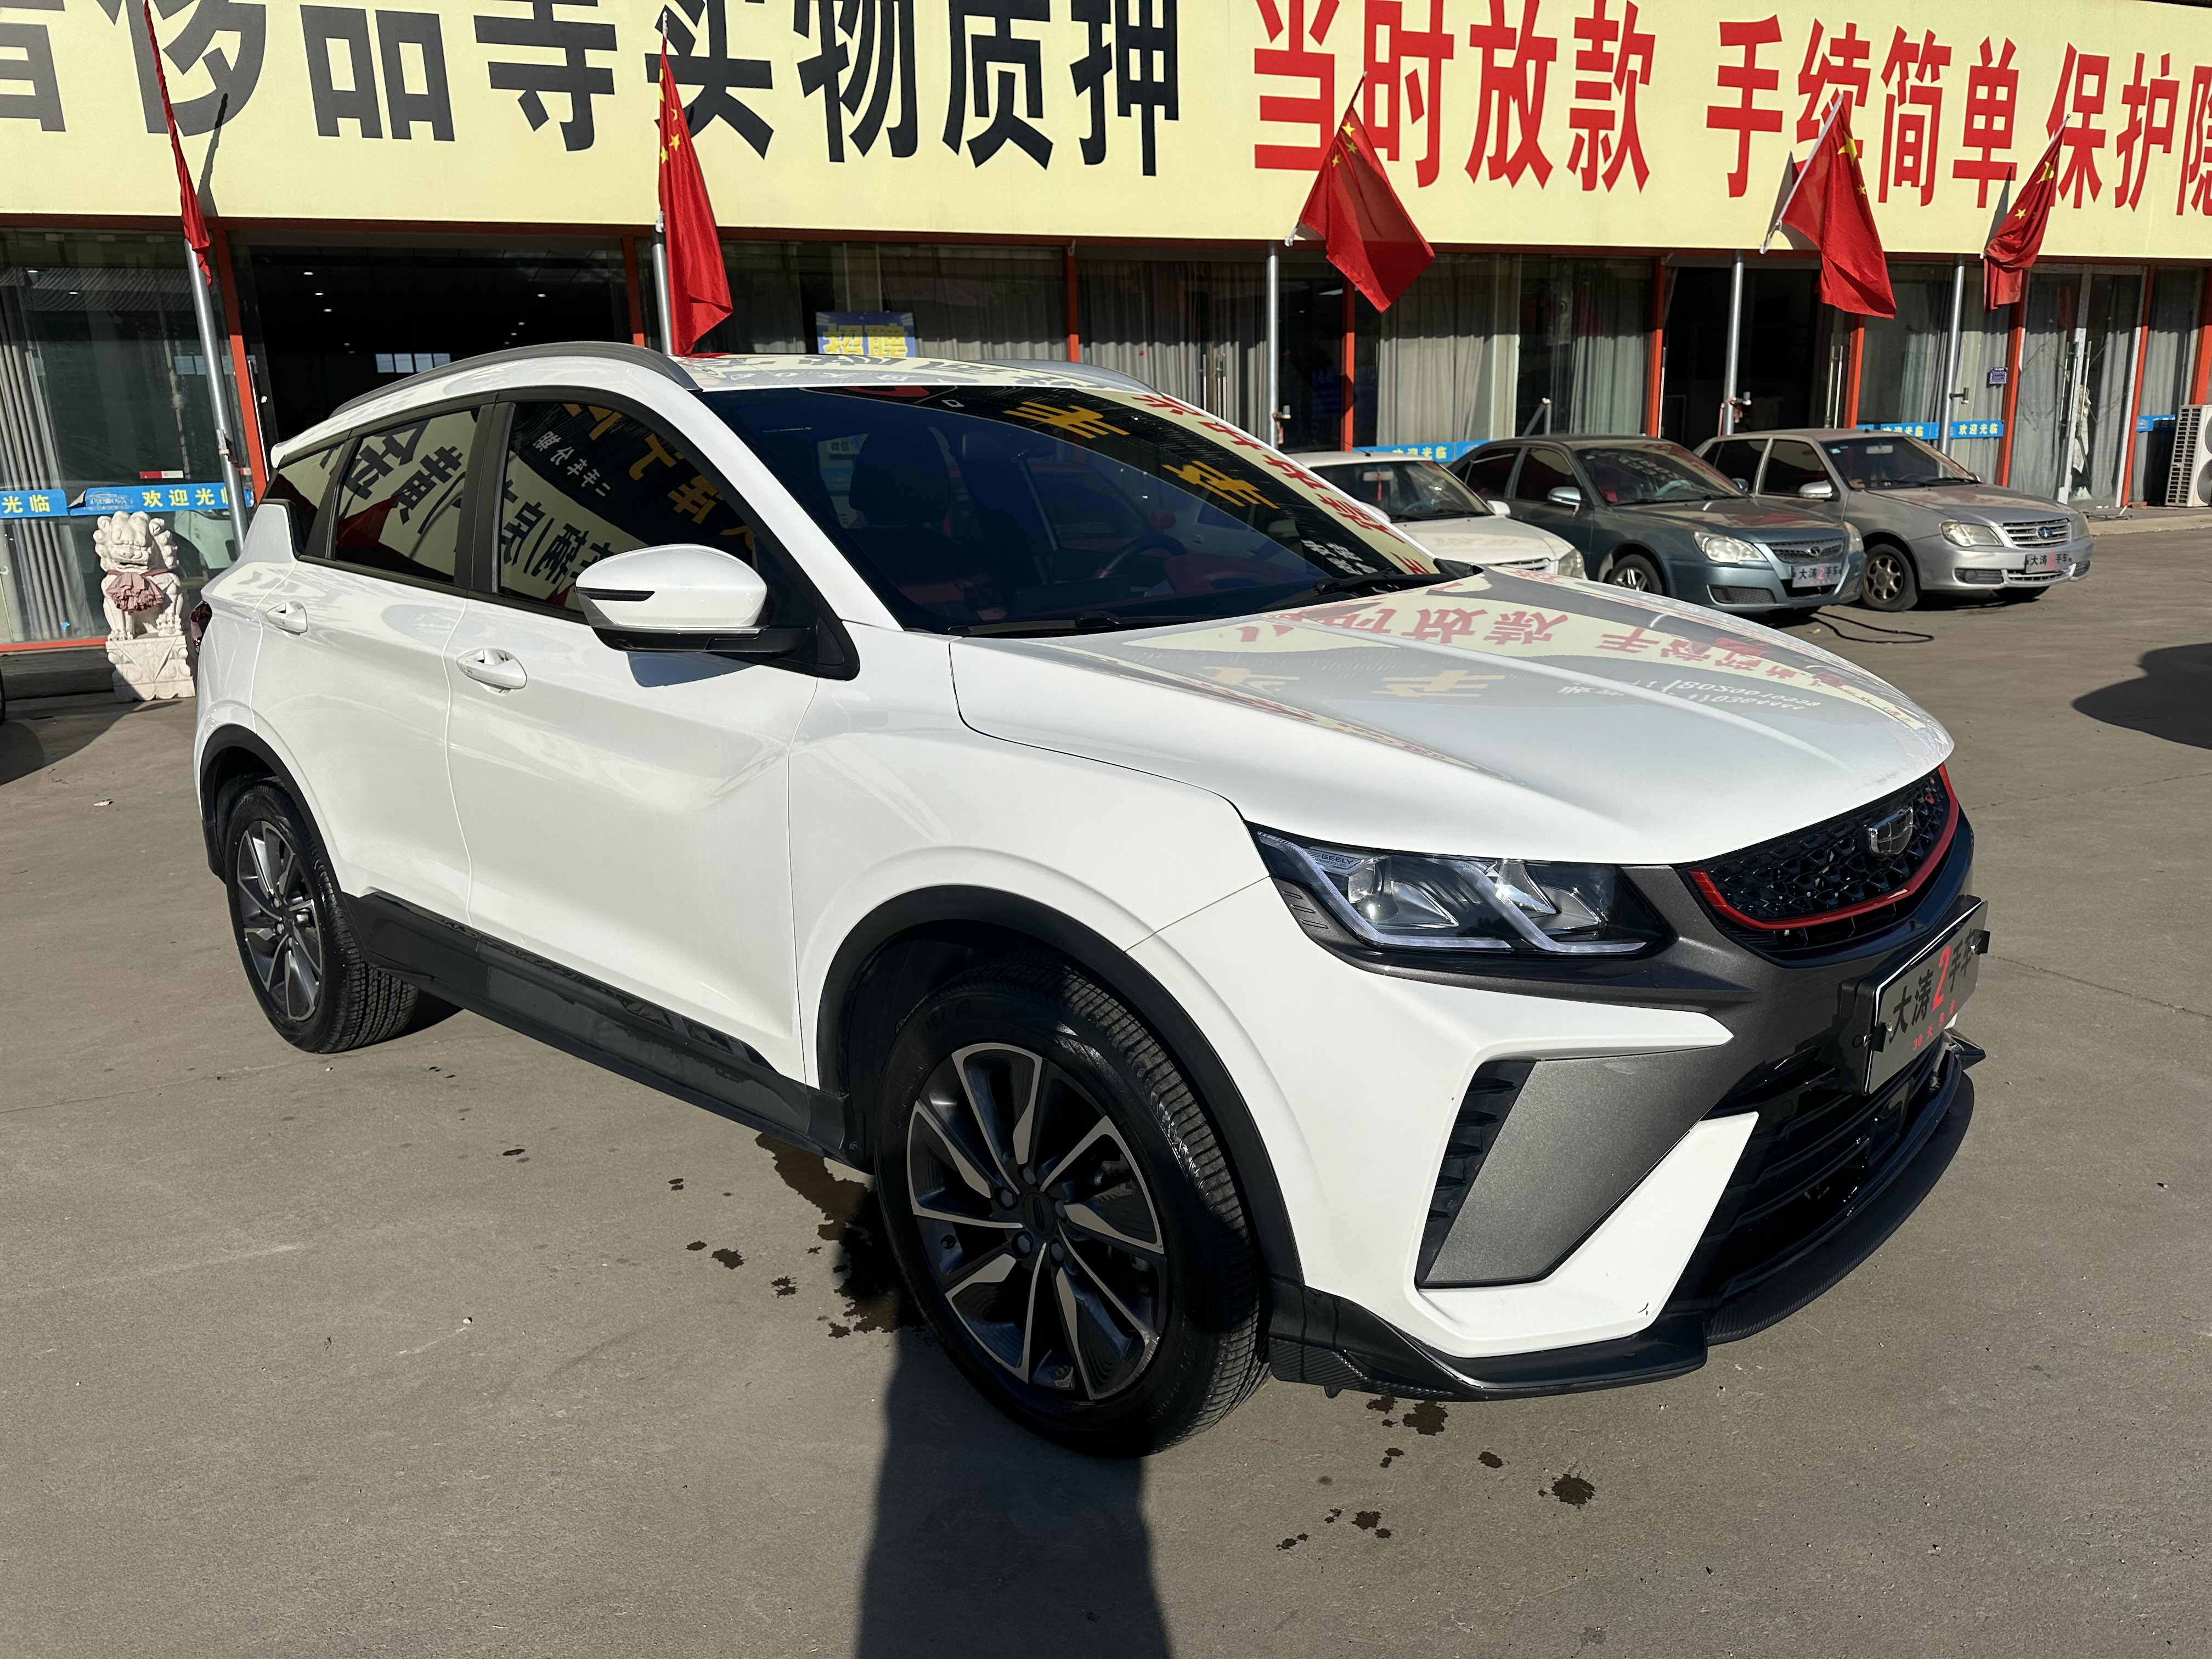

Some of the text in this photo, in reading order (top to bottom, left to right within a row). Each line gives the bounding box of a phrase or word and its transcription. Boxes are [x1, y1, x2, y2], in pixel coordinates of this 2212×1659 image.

[0, 0, 1180, 177] 侈品等实物质押
[823, 323, 908, 357] 招聘
[1958, 422, 1997, 435] 欢迎光临
[2, 494, 50, 514] 光临
[142, 487, 229, 508] 欢迎光
[1321, 854, 1354, 864] GEELY
